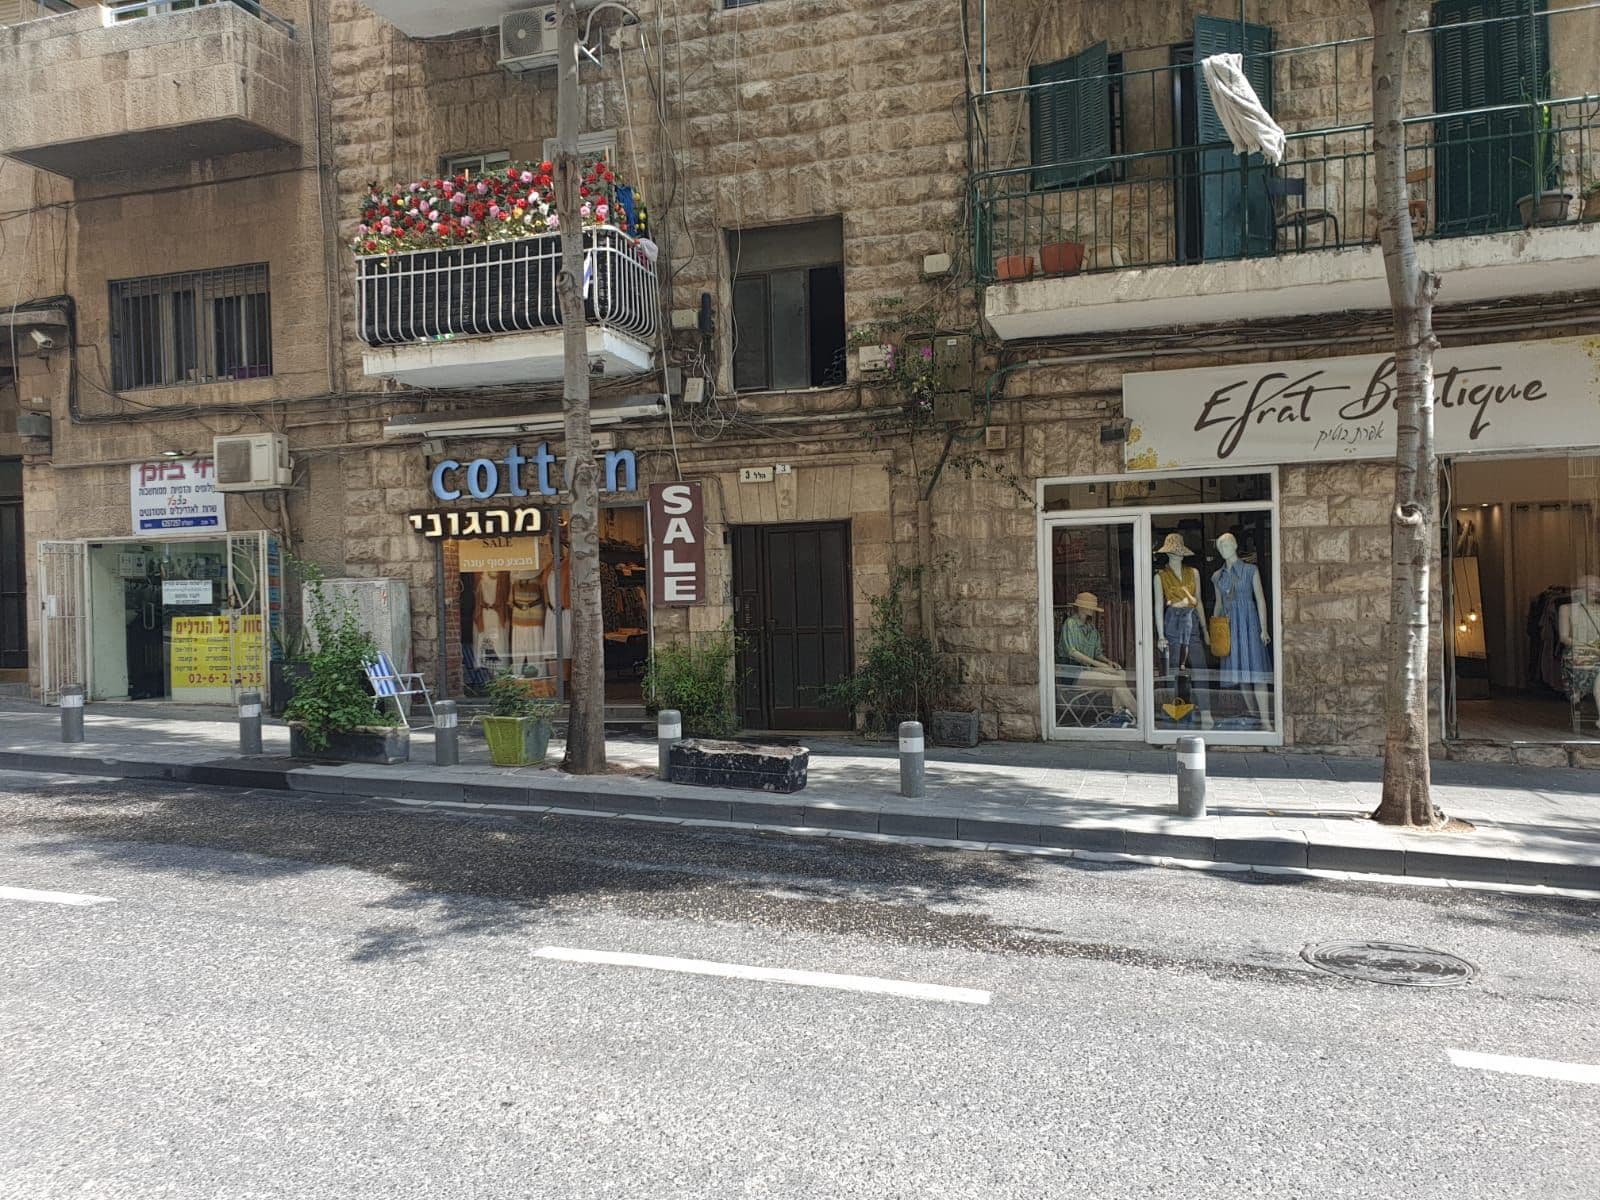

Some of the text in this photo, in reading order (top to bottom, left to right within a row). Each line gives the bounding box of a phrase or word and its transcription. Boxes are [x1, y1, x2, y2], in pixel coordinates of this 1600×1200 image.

[1194, 357, 1548, 459] Efrat Btique
[1313, 421, 1384, 451] אפרת בוטיק
[745, 470, 750, 480] 3
[781, 463, 786, 472] 3
[409, 506, 542, 537] מהגוני
[661, 485, 697, 601] SALE
